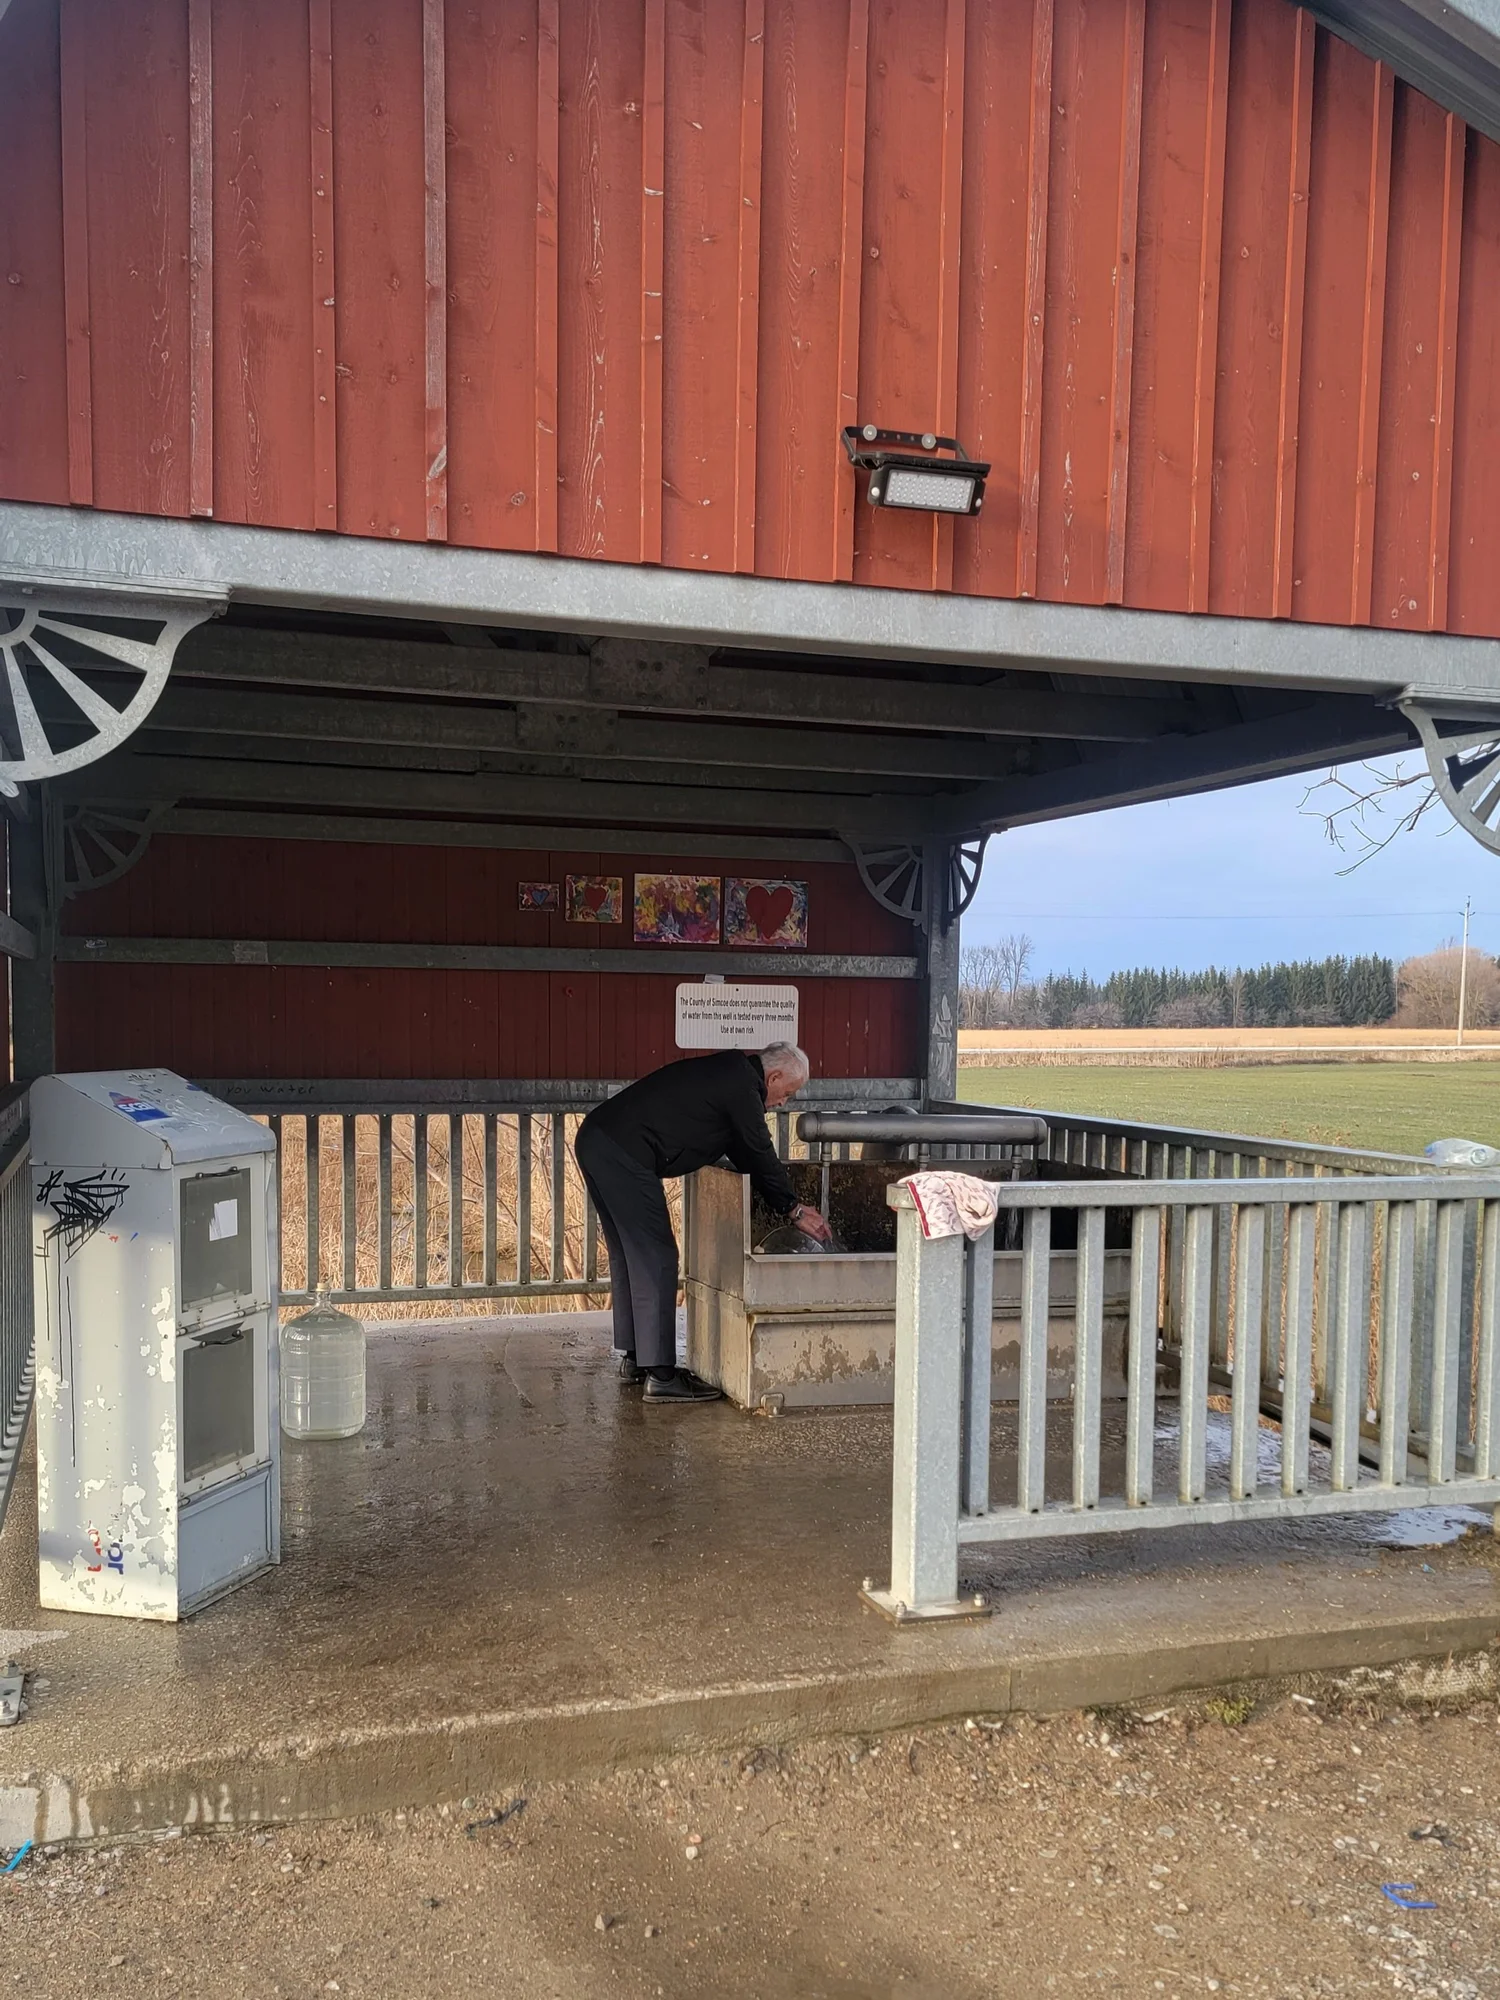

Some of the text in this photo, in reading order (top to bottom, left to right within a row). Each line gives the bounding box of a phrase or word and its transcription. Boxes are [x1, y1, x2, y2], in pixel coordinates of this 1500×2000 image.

[680, 996, 795, 1011] The County of Simcoe does not guarantee the quality
[682, 1010, 687, 1020] of
[687, 1011, 701, 1020] water
[701, 1011, 712, 1020] from
[713, 1011, 721, 1020] this
[722, 1012, 732, 1021] well
[737, 1012, 751, 1021] tested
[751, 1014, 764, 1023] every
[764, 1013, 776, 1022] three
[777, 1013, 794, 1022] months
[720, 1025, 729, 1034] Use
[729, 1025, 735, 1034] at
[745, 1025, 755, 1034] risk
